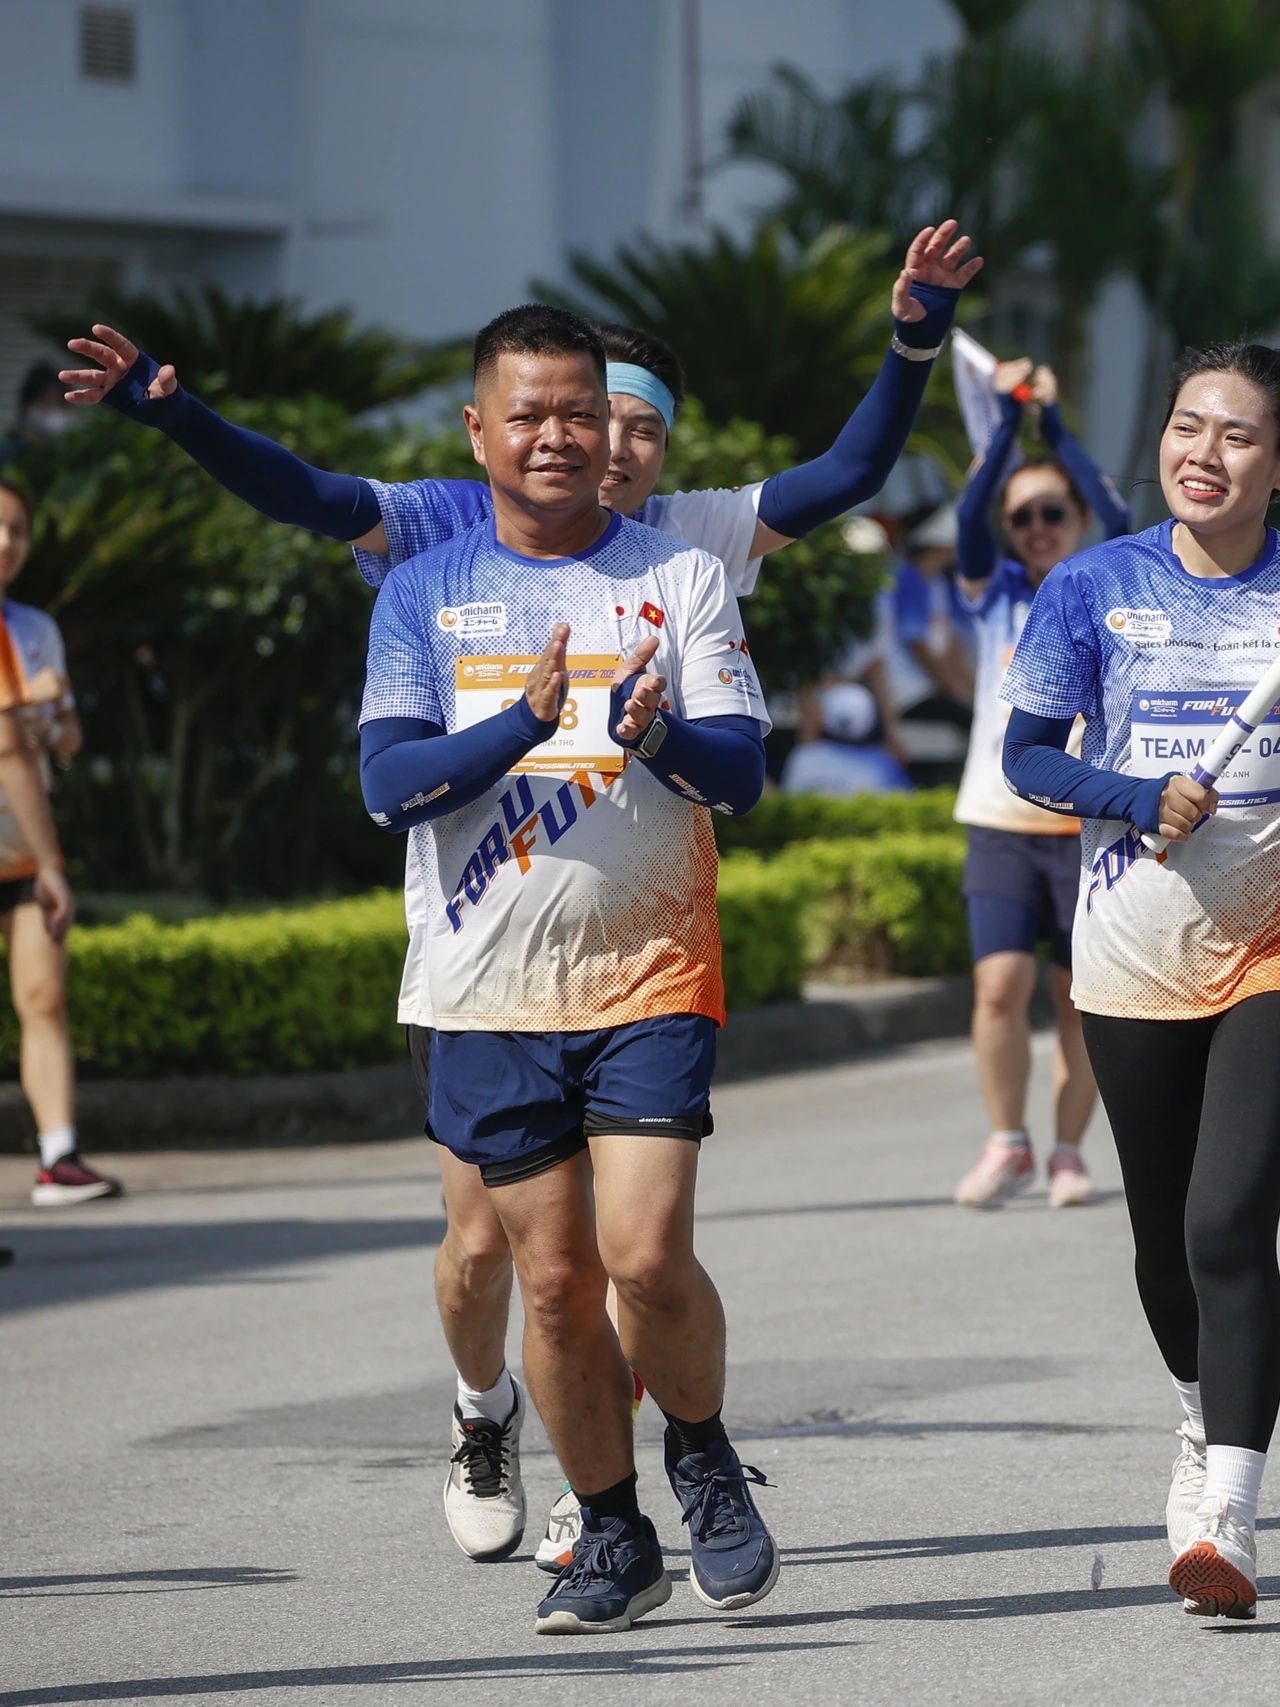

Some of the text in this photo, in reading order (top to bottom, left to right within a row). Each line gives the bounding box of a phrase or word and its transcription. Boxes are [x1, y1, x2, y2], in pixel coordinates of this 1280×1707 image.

[460, 605, 502, 617] unicharm
[1127, 611, 1169, 622] unicharm
[1134, 640, 1161, 649] Sales
[1140, 737, 1205, 759] TEAM
[534, 762, 596, 770] POSSIBILITIES
